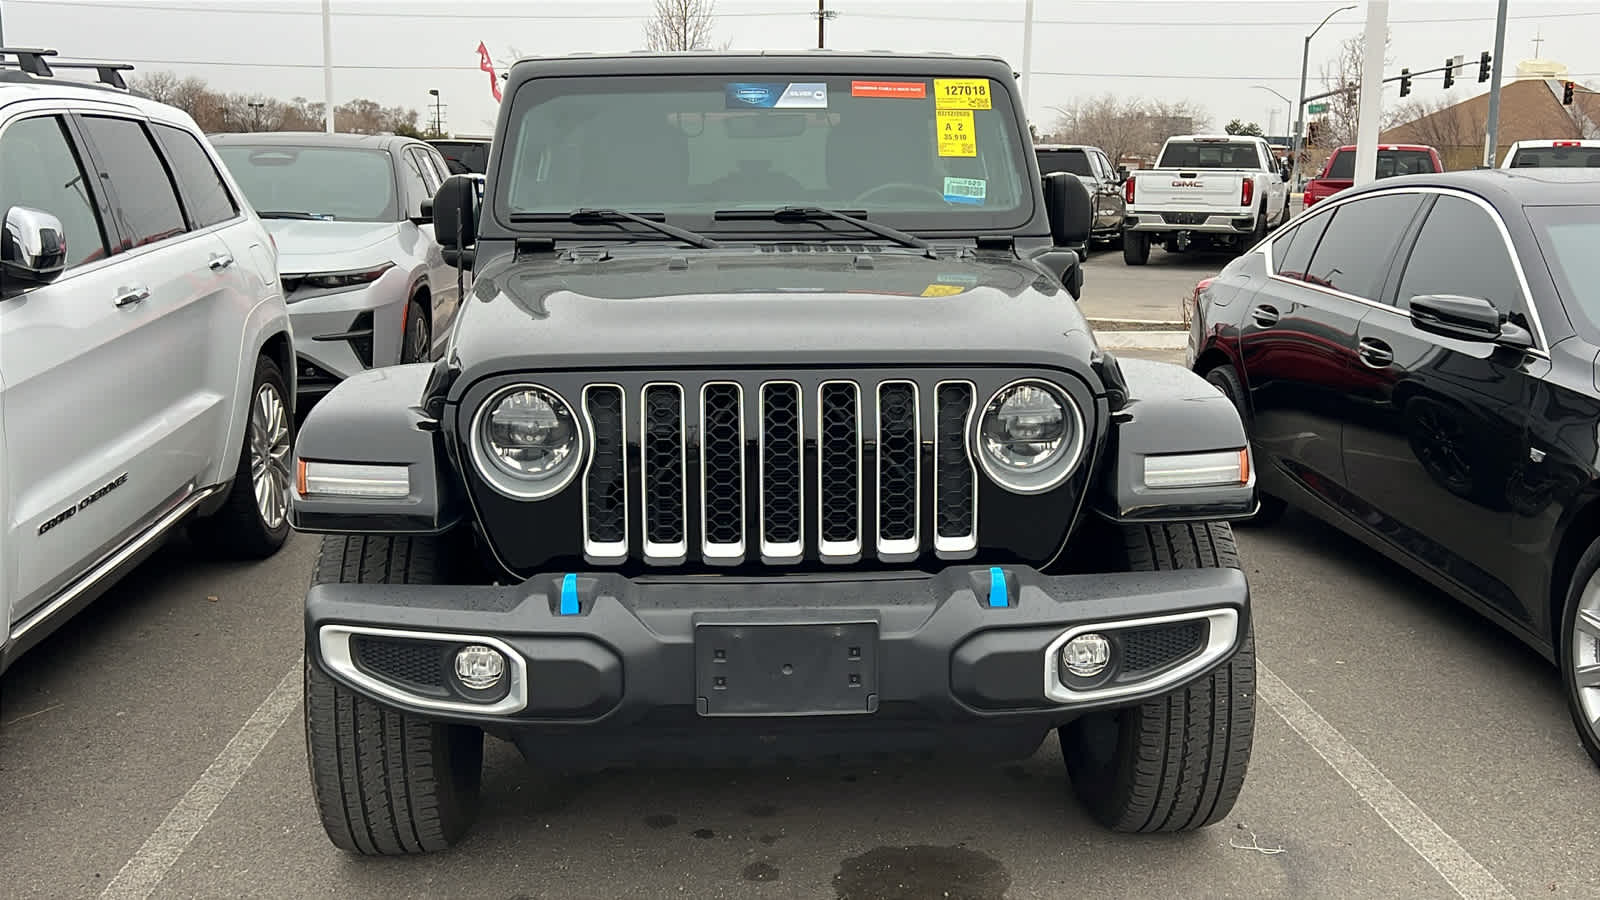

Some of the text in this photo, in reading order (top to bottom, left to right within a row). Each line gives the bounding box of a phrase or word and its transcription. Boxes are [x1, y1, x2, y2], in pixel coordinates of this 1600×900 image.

[944, 85, 986, 96] 127018
[945, 123, 963, 131] A 2
[38, 472, 128, 536] GRAND CHEROKEE
